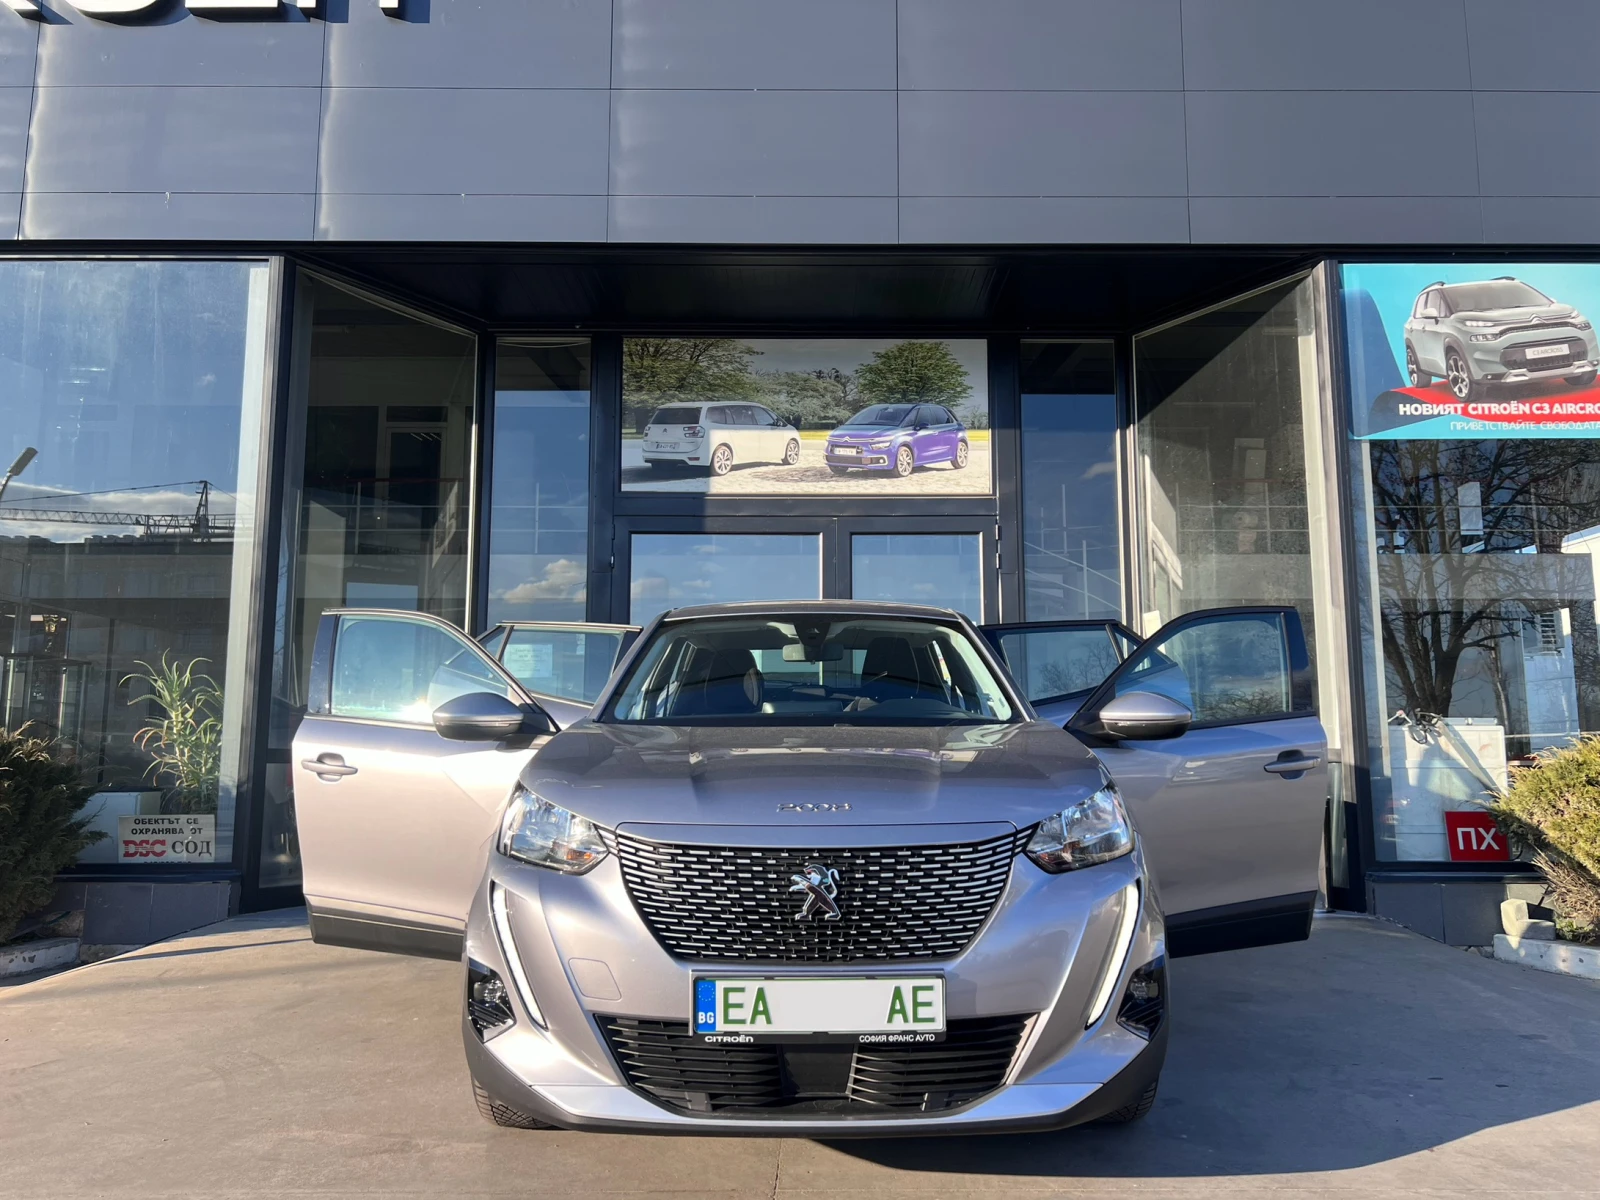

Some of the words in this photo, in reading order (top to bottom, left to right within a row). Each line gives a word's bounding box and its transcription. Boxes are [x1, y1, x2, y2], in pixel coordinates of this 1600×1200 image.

[1398, 403, 1464, 415] НОВИЯТ
[1467, 400, 1531, 415] CITROËN
[1532, 402, 1550, 415] C3
[1450, 419, 1537, 431] ПРИВЕТСТВАЙТЕ
[776, 803, 853, 813] 2008
[133, 817, 181, 825] ОБЕКТЪТ
[186, 817, 199, 825] СЕ
[131, 827, 185, 835] ОХРАНЯВА
[189, 827, 203, 835] ОТ
[1456, 827, 1501, 850] ПХ
[122, 839, 167, 858] DSC
[171, 840, 212, 858] СОД
[723, 987, 773, 1025] EA
[886, 985, 936, 1023] AE
[698, 1011, 714, 1024] BG
[859, 1035, 887, 1043] СОФИЯ
[888, 1034, 914, 1042] ФРАНС
[916, 1033, 935, 1042] АУТО
